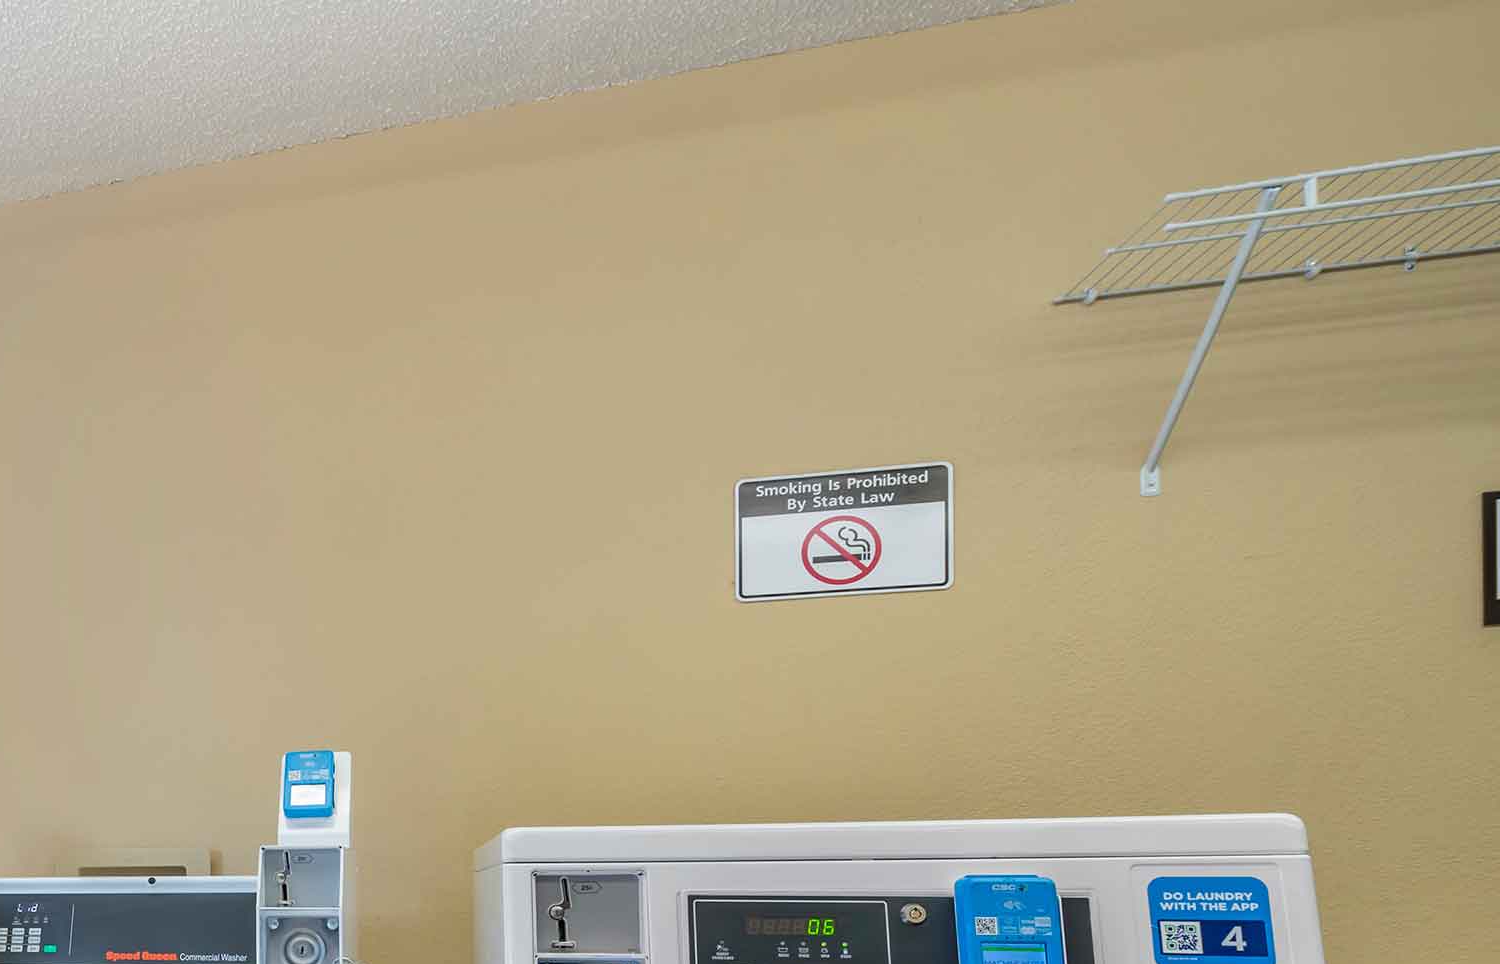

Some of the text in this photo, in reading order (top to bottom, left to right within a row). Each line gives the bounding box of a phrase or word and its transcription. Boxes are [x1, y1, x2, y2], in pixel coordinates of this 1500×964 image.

[755, 470, 929, 498] Smoking Is Prohibited
[787, 491, 895, 512] By State Law
[1163, 891, 1253, 901] DO LAUNDRY
[1160, 902, 1259, 911] WITH THE APP
[807, 918, 835, 936] 06
[1220, 925, 1248, 952] 4
[105, 950, 248, 962] Speed Queen Commercial Washer
